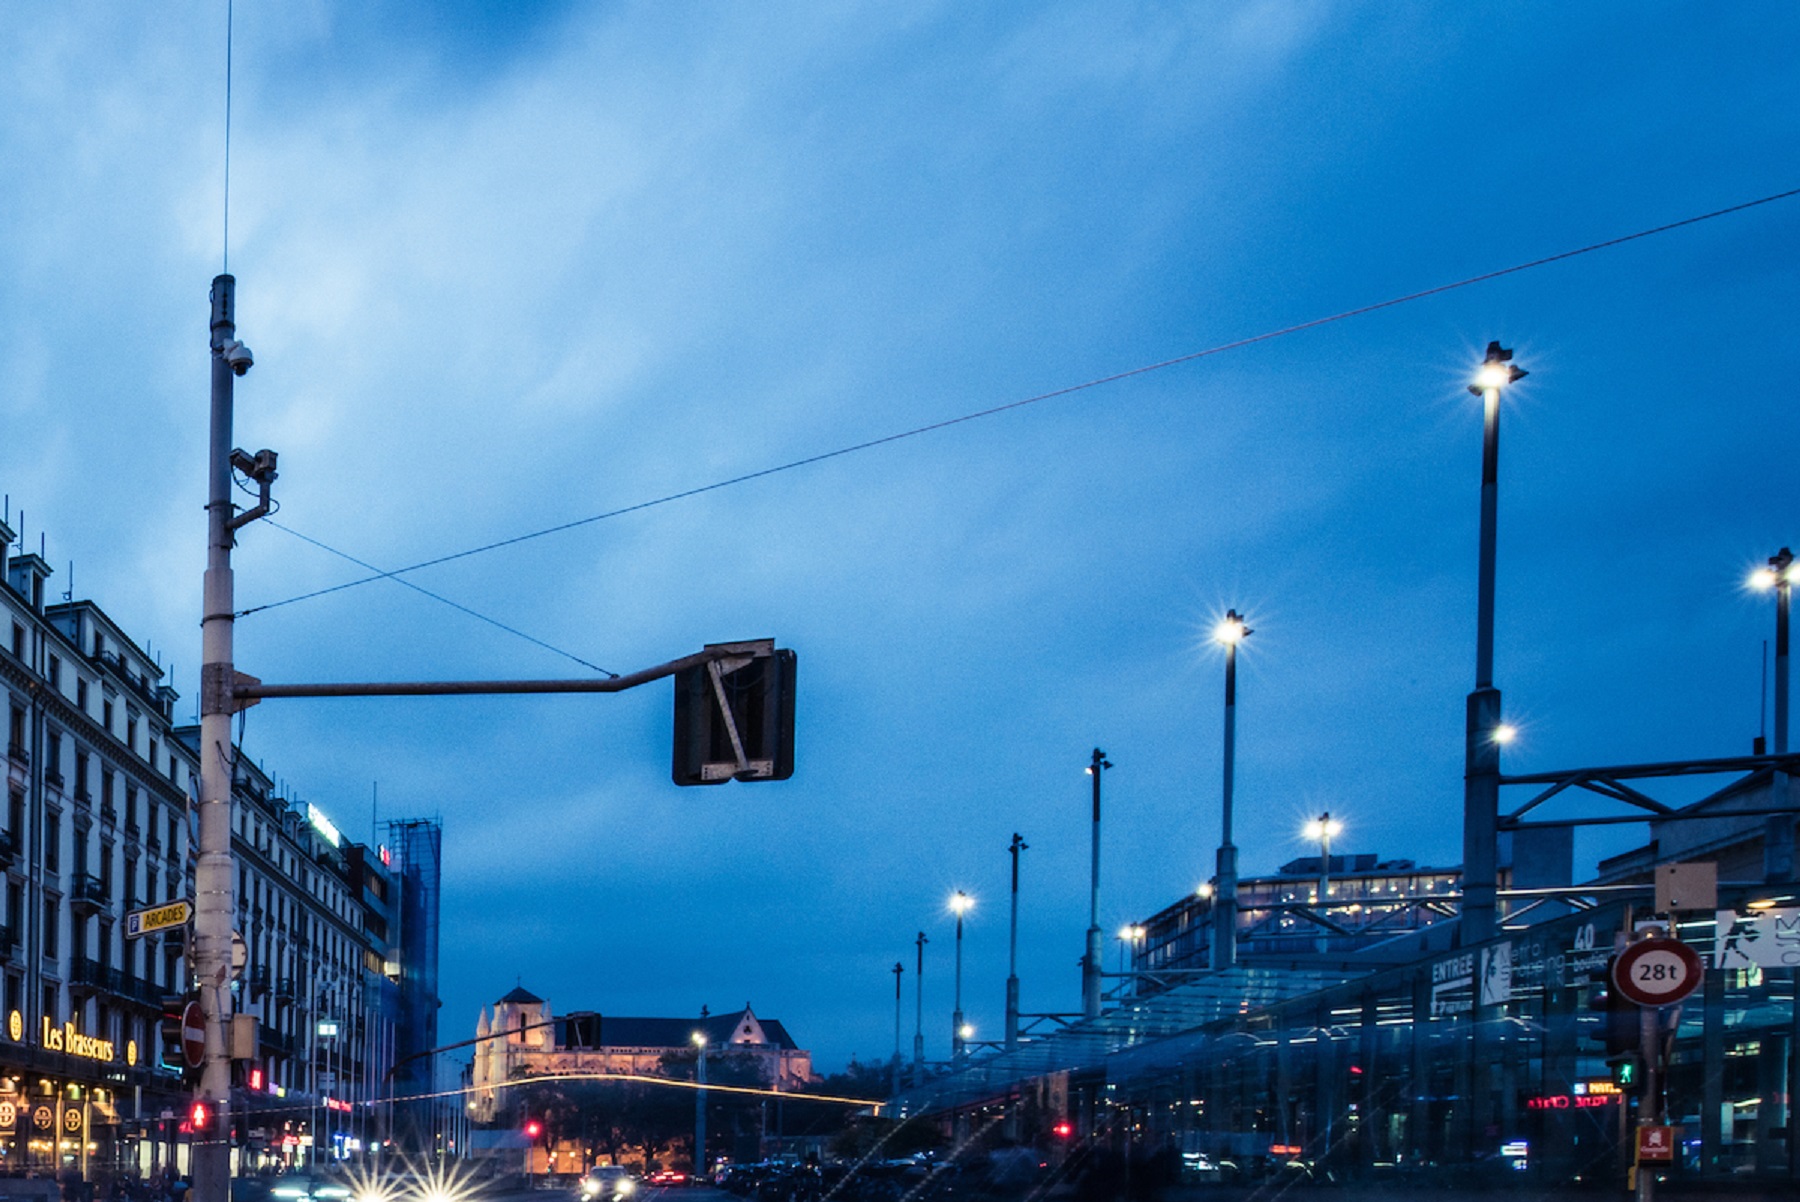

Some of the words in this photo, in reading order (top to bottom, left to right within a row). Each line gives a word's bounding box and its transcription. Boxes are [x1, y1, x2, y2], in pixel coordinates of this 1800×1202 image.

[145, 905, 184, 927] ARCADES
[43, 1016, 62, 1051] Les
[65, 1022, 114, 1062] Brasseurs
